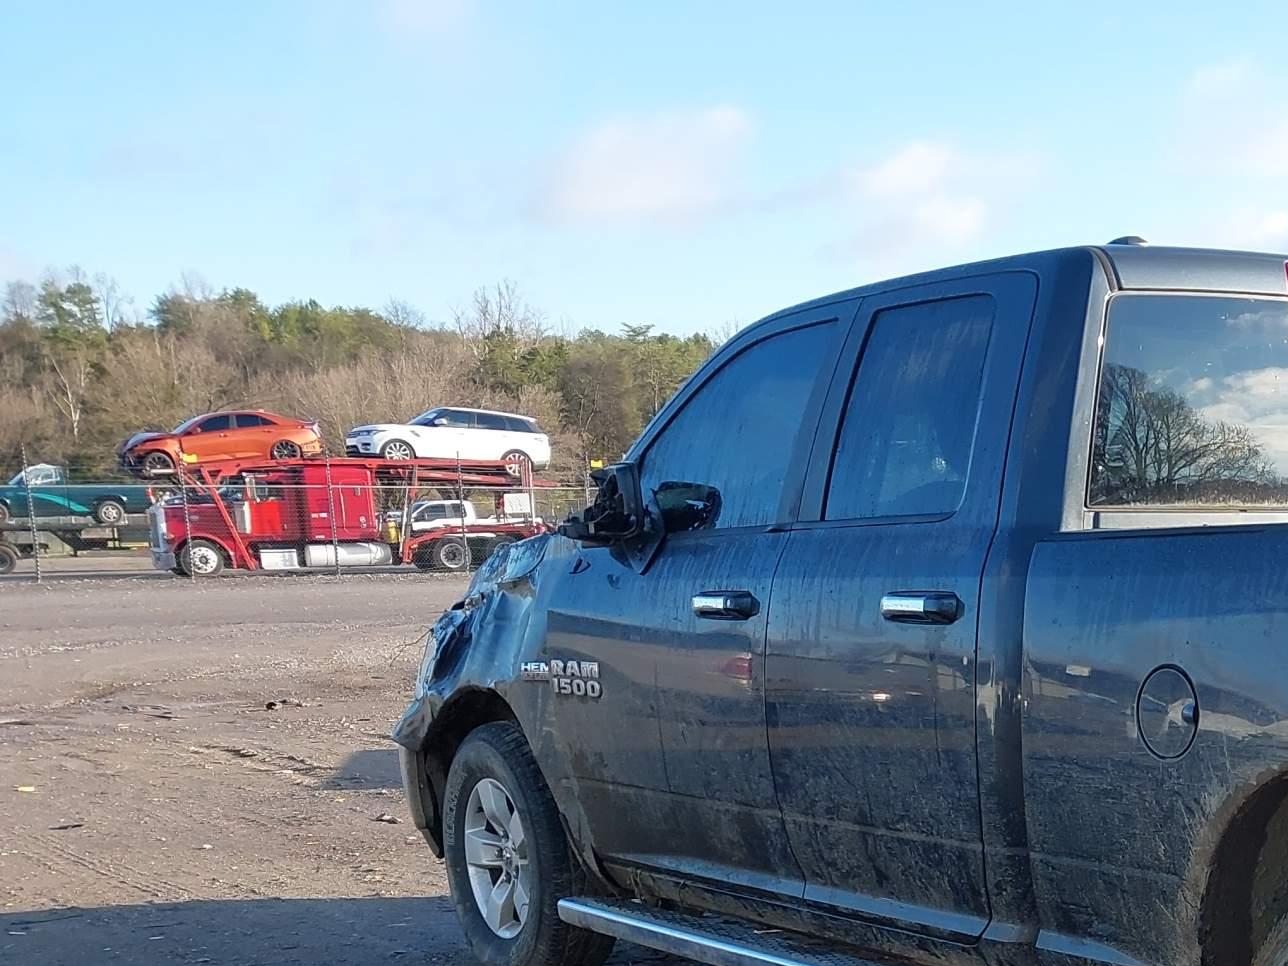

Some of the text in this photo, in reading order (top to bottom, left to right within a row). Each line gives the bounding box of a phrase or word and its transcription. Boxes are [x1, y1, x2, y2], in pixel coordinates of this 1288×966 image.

[520, 662, 549, 672] HEM
[550, 659, 599, 678] RAM
[552, 677, 602, 698] 1500
